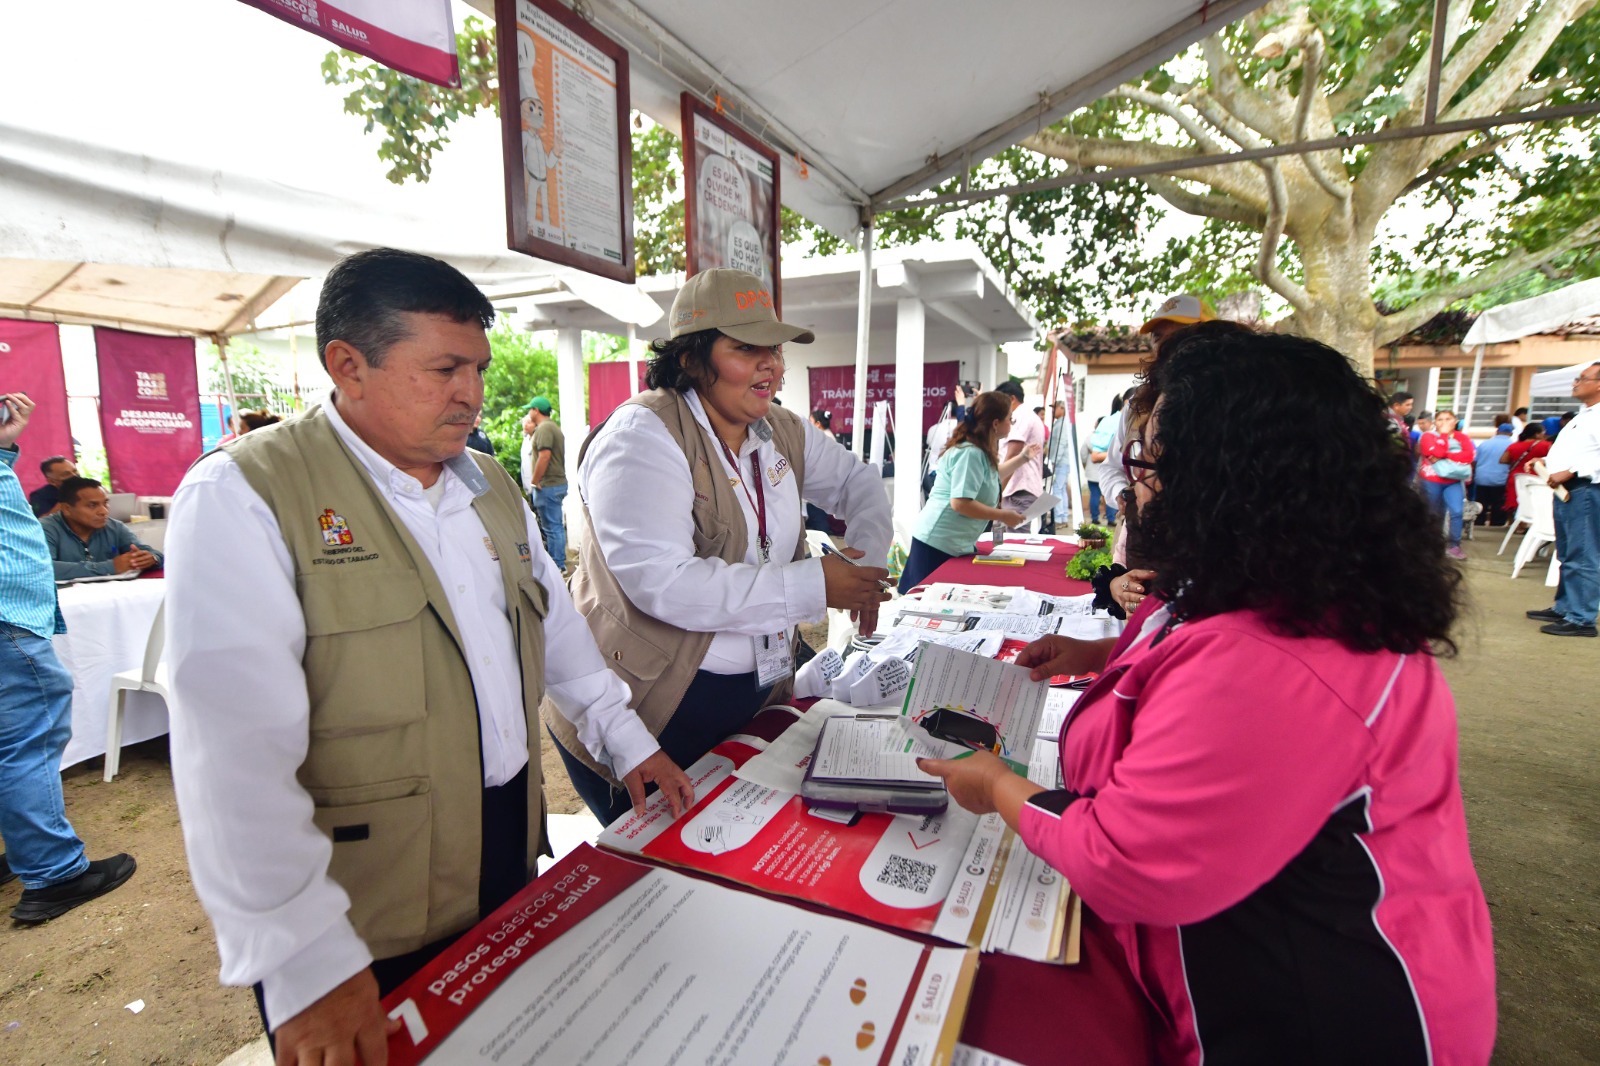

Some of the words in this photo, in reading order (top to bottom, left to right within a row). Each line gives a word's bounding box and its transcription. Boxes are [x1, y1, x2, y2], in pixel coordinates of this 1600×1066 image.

[331, 19, 367, 40] SALUD
[712, 166, 721, 179] ES
[723, 172, 738, 188] QUE
[704, 190, 747, 218] CREDENCIAL
[733, 236, 742, 248] ES
[744, 240, 759, 254] QUE
[733, 248, 744, 260] NO
[745, 252, 760, 265] HAY
[877, 389, 885, 398] Y
[114, 418, 193, 429] AGROPECUARIO
[120, 410, 186, 421] DESARROLLO
[346, 553, 379, 564] TABASCO
[646, 803, 659, 813] las
[626, 812, 662, 840] adversas
[752, 844, 780, 872] NOTIFICA
[778, 820, 800, 845] cualquier
[764, 850, 787, 876] reacción
[785, 831, 804, 852] adversa
[784, 834, 827, 882] farmacovigilancia
[815, 853, 824, 862] de
[972, 837, 989, 866] COFEPRIS
[774, 870, 784, 879] tu
[781, 849, 800, 871] unidad
[798, 842, 806, 851] de
[957, 880, 972, 905] SALUD
[1031, 891, 1046, 918] SALUD
[427, 942, 491, 996] pasos
[487, 891, 555, 943] básicos
[553, 863, 589, 893] para
[448, 929, 536, 1005] proteger
[534, 912, 559, 929] tu
[557, 874, 601, 912] salud
[921, 973, 942, 1010] SALUD
